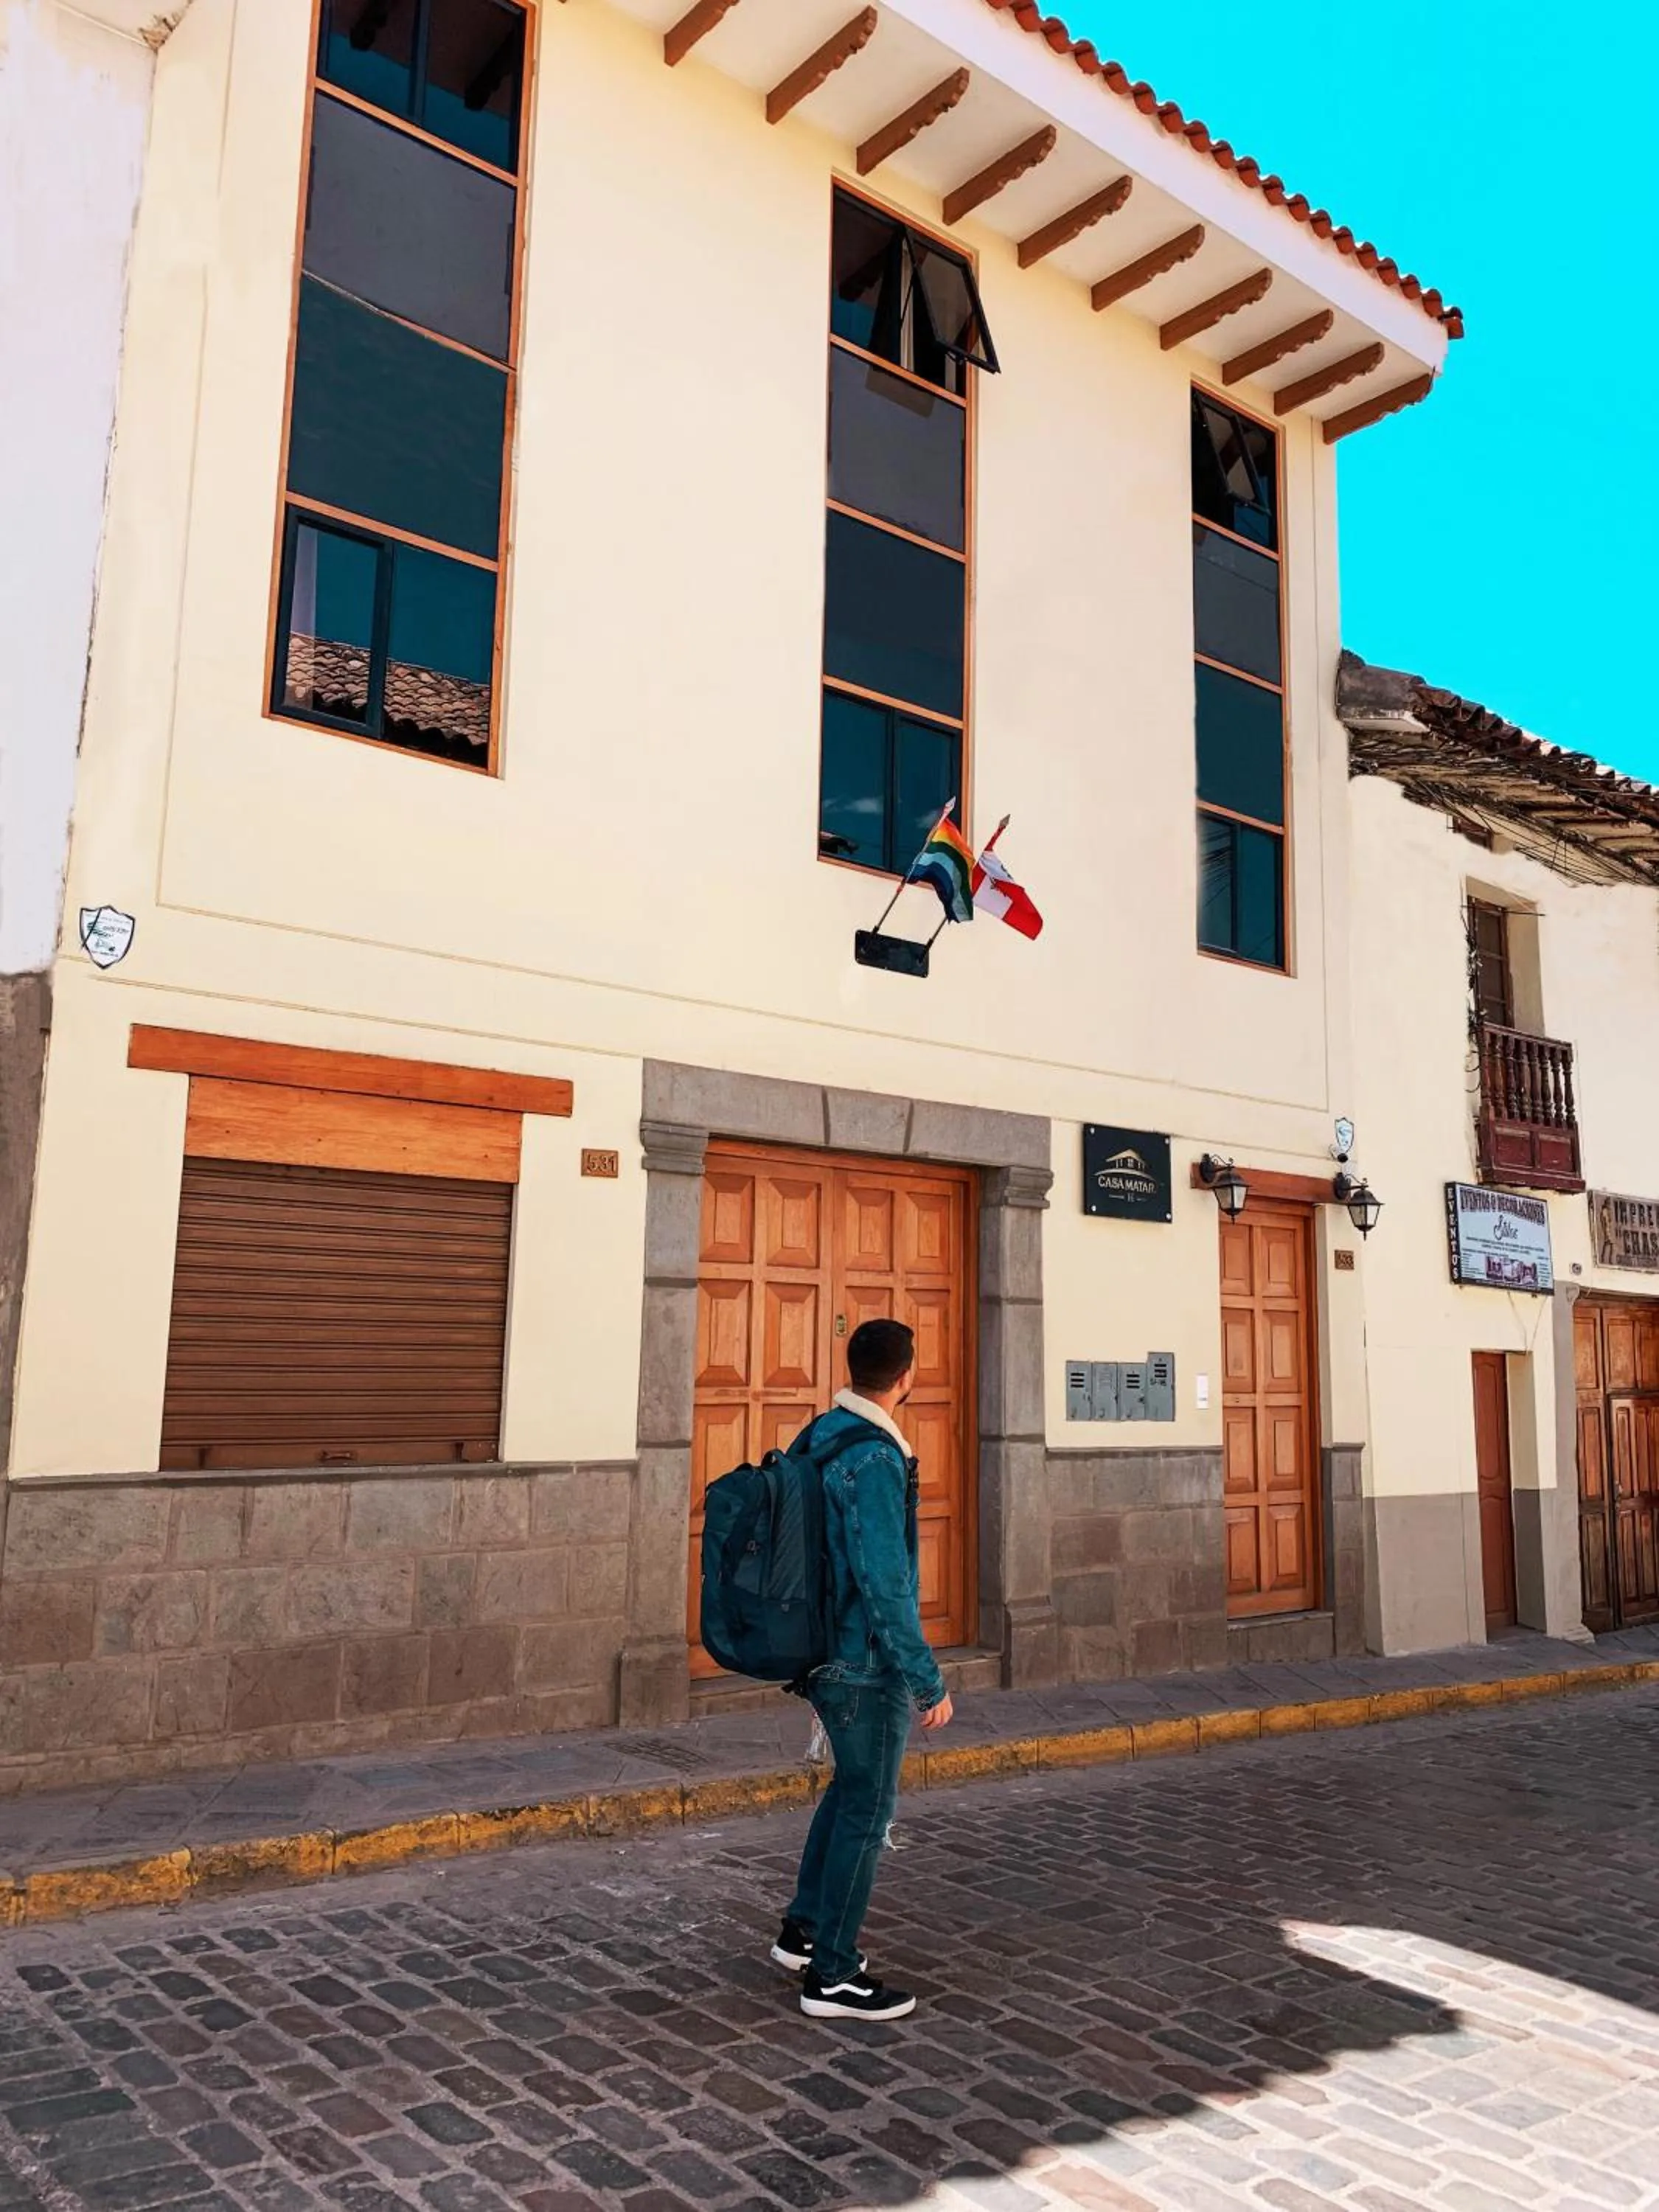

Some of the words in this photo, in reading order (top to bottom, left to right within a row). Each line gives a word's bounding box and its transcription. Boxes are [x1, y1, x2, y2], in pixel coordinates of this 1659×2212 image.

[1098, 1175, 1124, 1189] CASA
[1125, 1179, 1156, 1194] MATAR
[1447, 1188, 1459, 1279] EVENTOS
